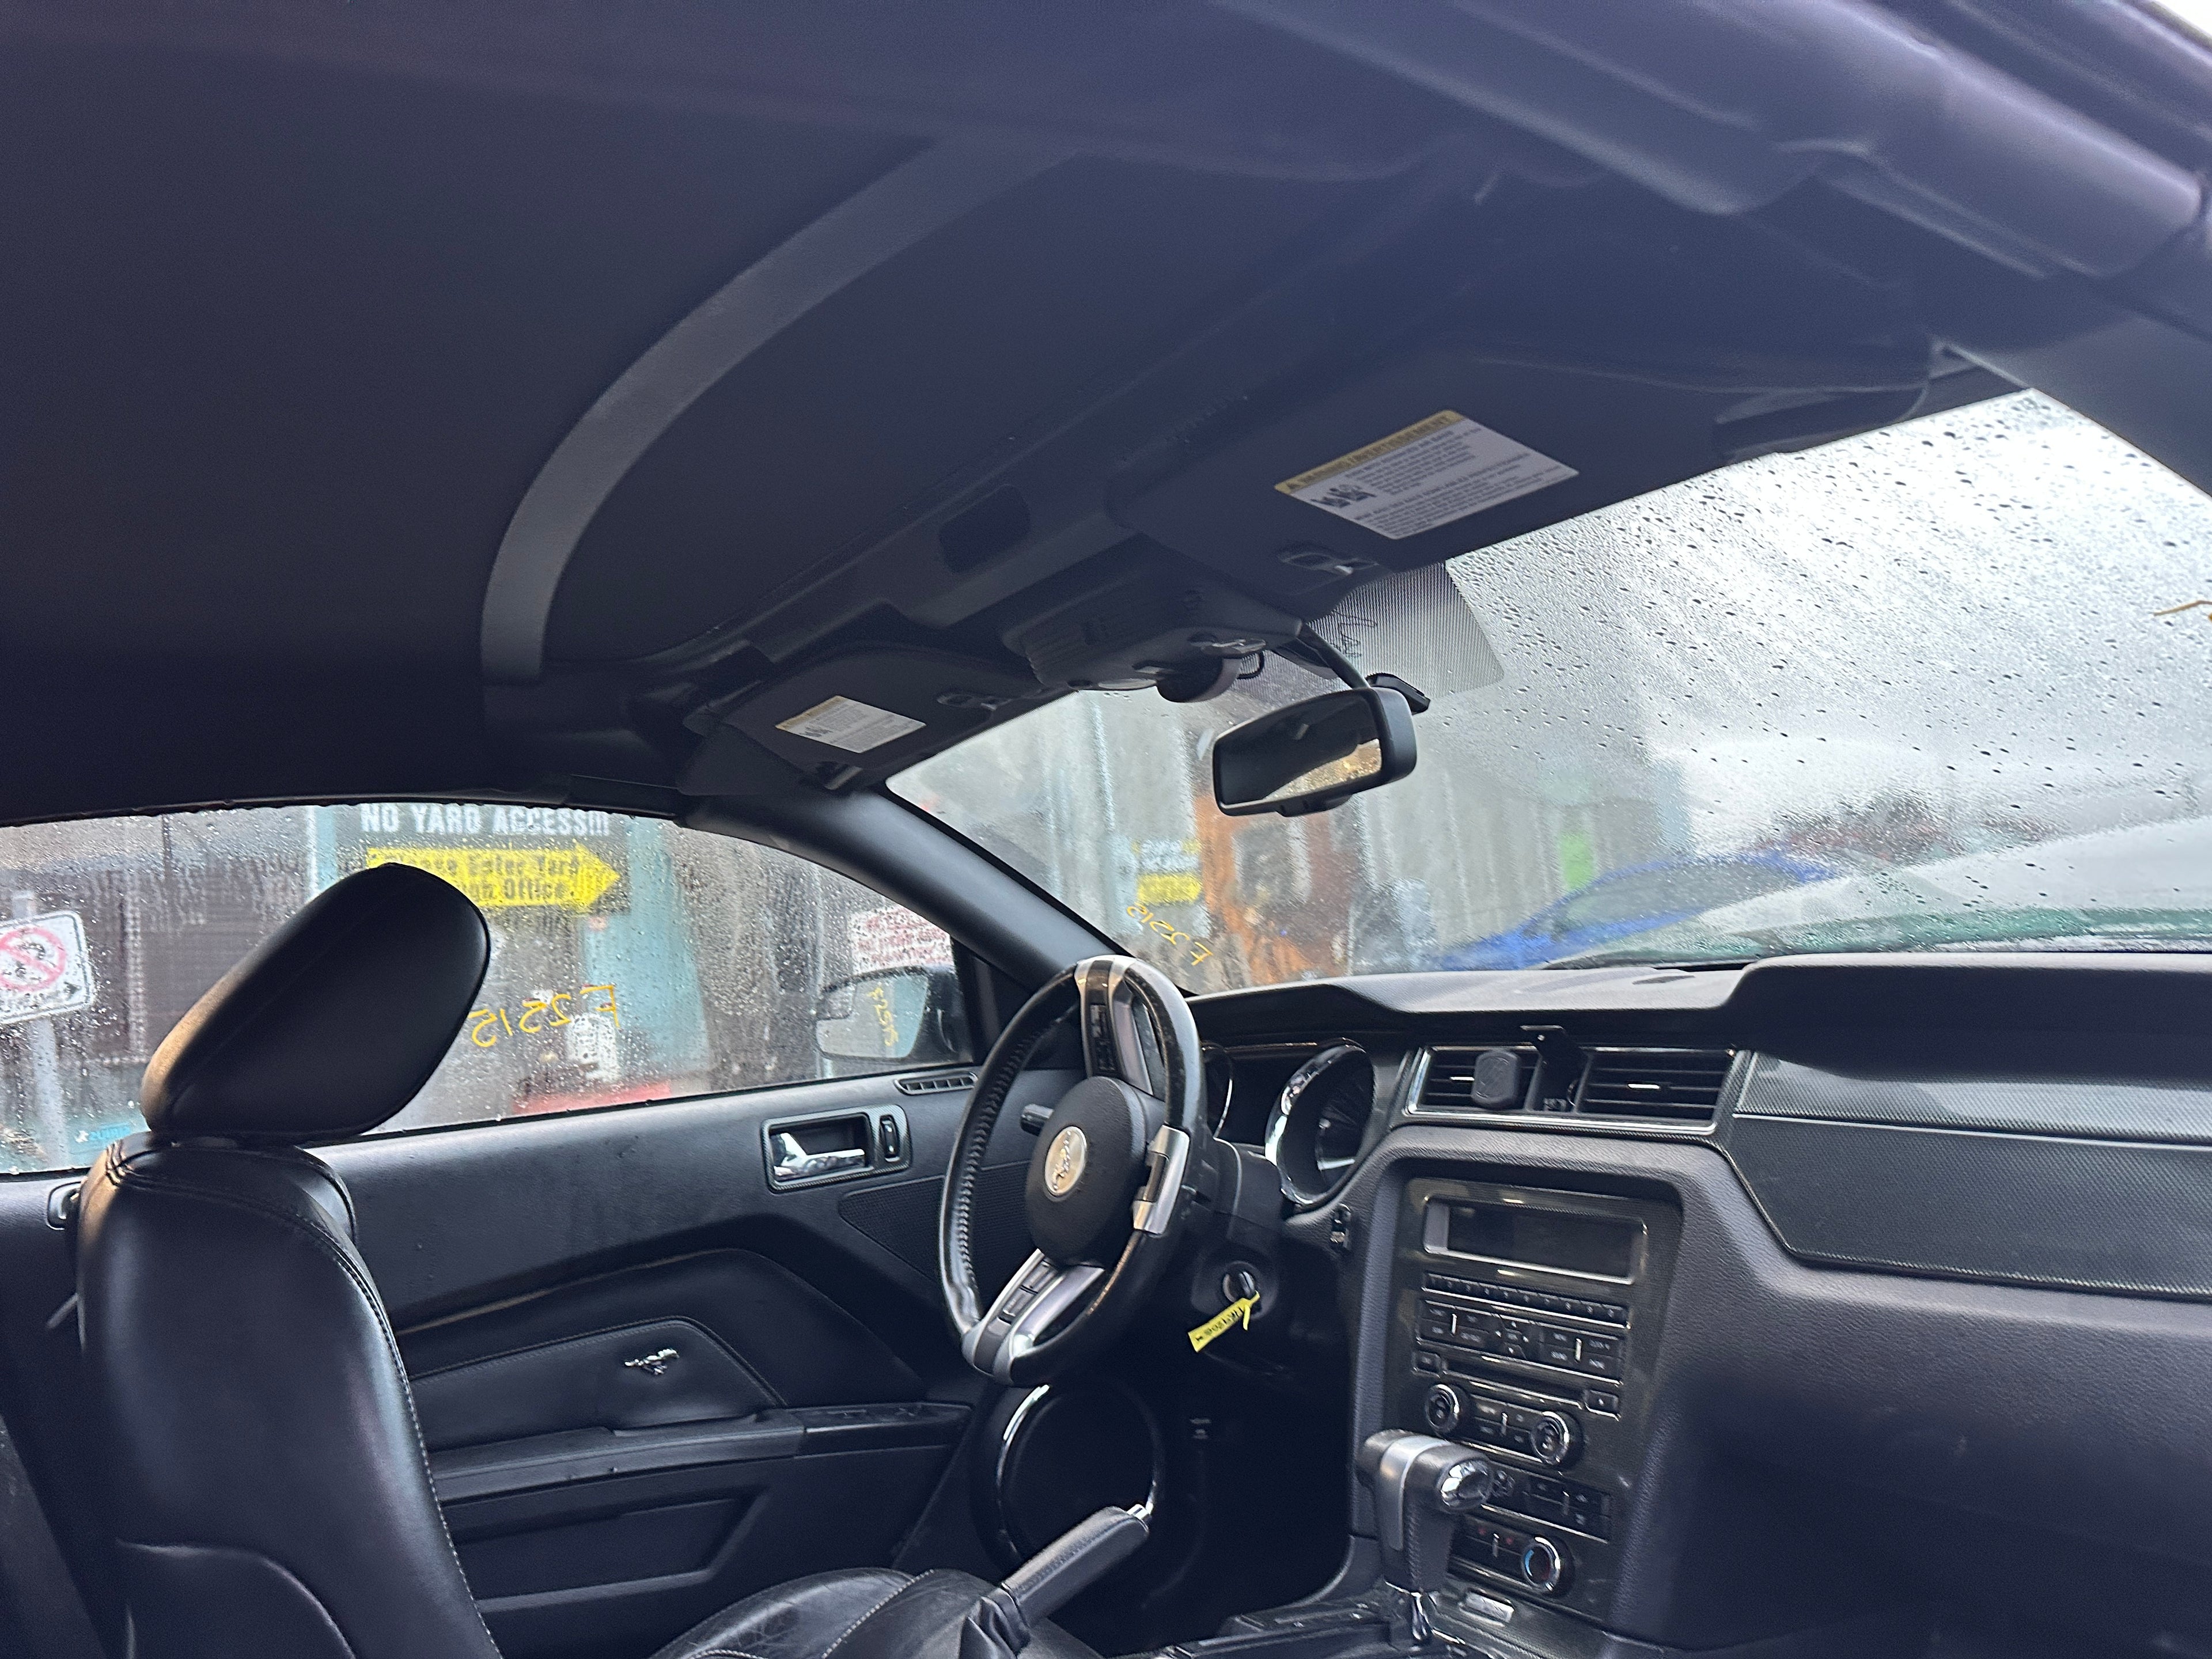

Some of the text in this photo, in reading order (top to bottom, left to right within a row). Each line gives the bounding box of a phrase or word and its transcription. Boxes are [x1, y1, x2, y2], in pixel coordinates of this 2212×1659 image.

[361, 804, 399, 833] NO
[413, 804, 482, 835] YARD
[503, 878, 566, 900] Office
